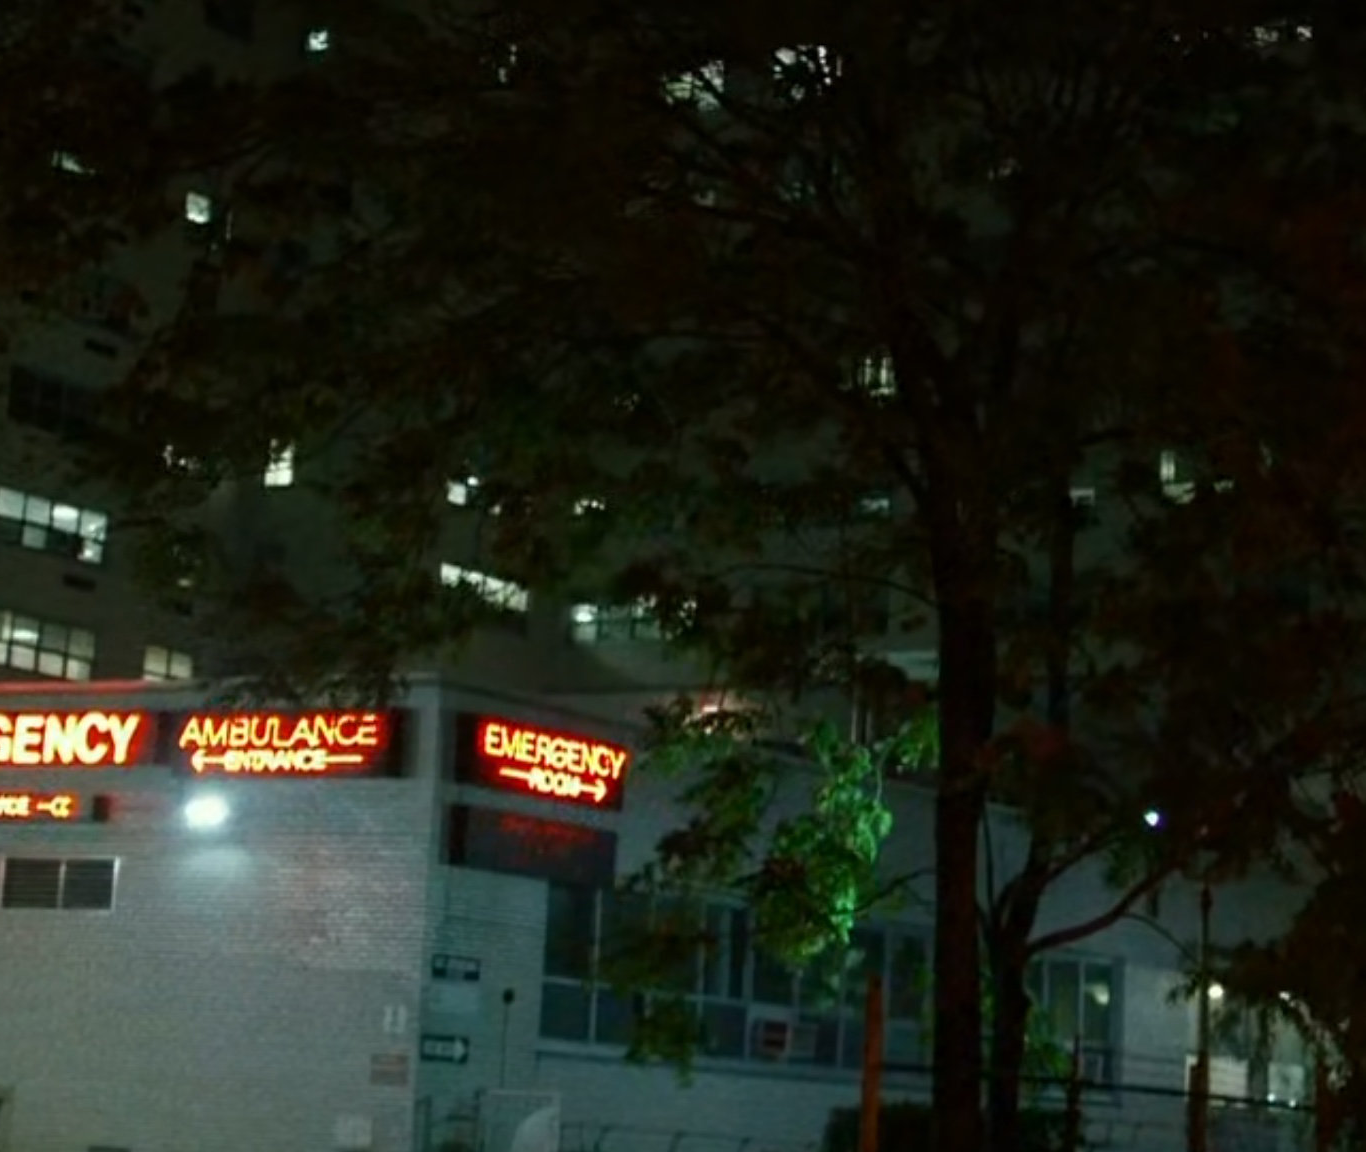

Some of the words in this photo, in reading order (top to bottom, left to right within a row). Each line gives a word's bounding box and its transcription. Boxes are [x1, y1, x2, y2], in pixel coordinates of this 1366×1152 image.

[179, 714, 378, 748] AMBULANCE
[222, 748, 328, 773] ENTRANCE
[484, 722, 627, 780] EMERGENCY
